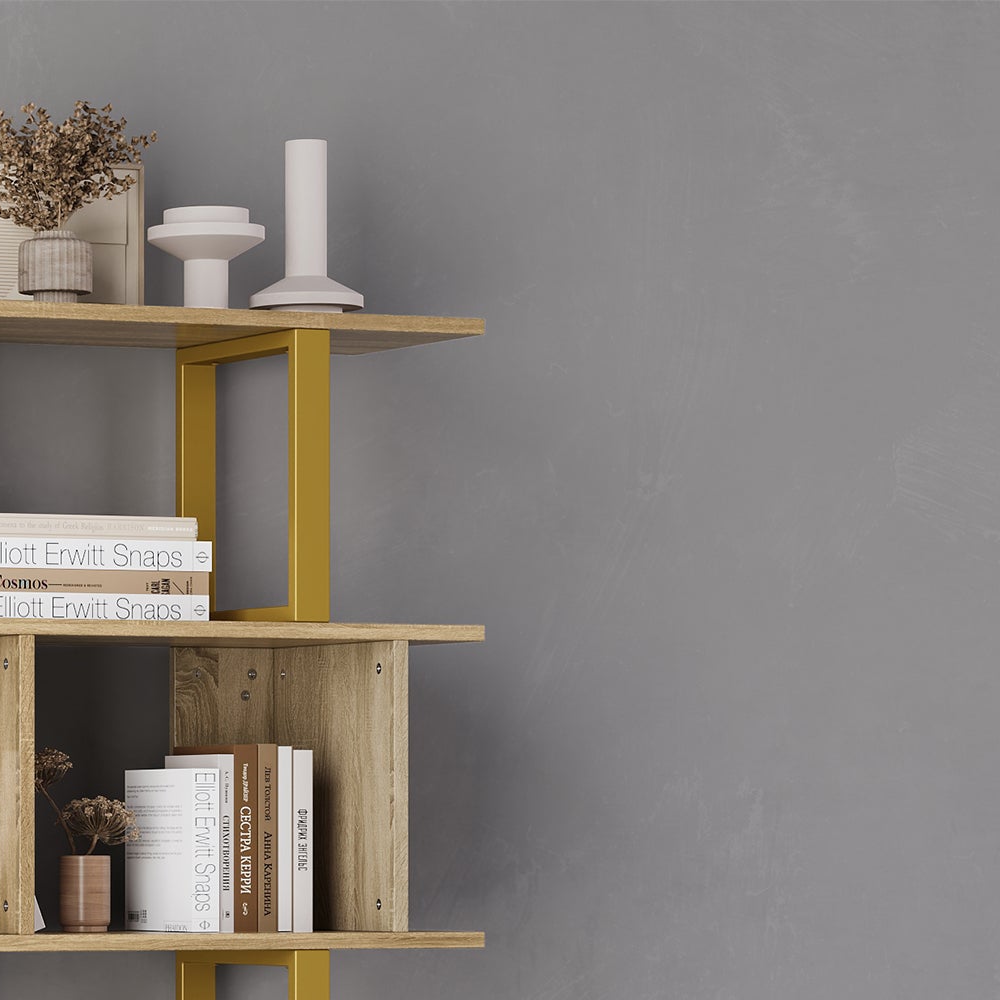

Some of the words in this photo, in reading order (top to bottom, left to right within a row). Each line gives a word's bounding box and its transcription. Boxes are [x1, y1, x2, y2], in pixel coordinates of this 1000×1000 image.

[46, 542, 104, 566] Erwitt
[113, 544, 182, 571] Snaps
[150, 580, 160, 594] CARL
[52, 596, 114, 619] Erwitt
[116, 598, 182, 620] Snaps
[194, 772, 216, 812] Elliott
[194, 816, 216, 858] Erwitt
[240, 806, 252, 852] СЕСТРА
[298, 808, 308, 840] ФРИДРИХ
[240, 855, 252, 894] КЕРРИ
[298, 842, 308, 872] ЭНГЕЛЬС
[192, 864, 216, 912] Snaps
